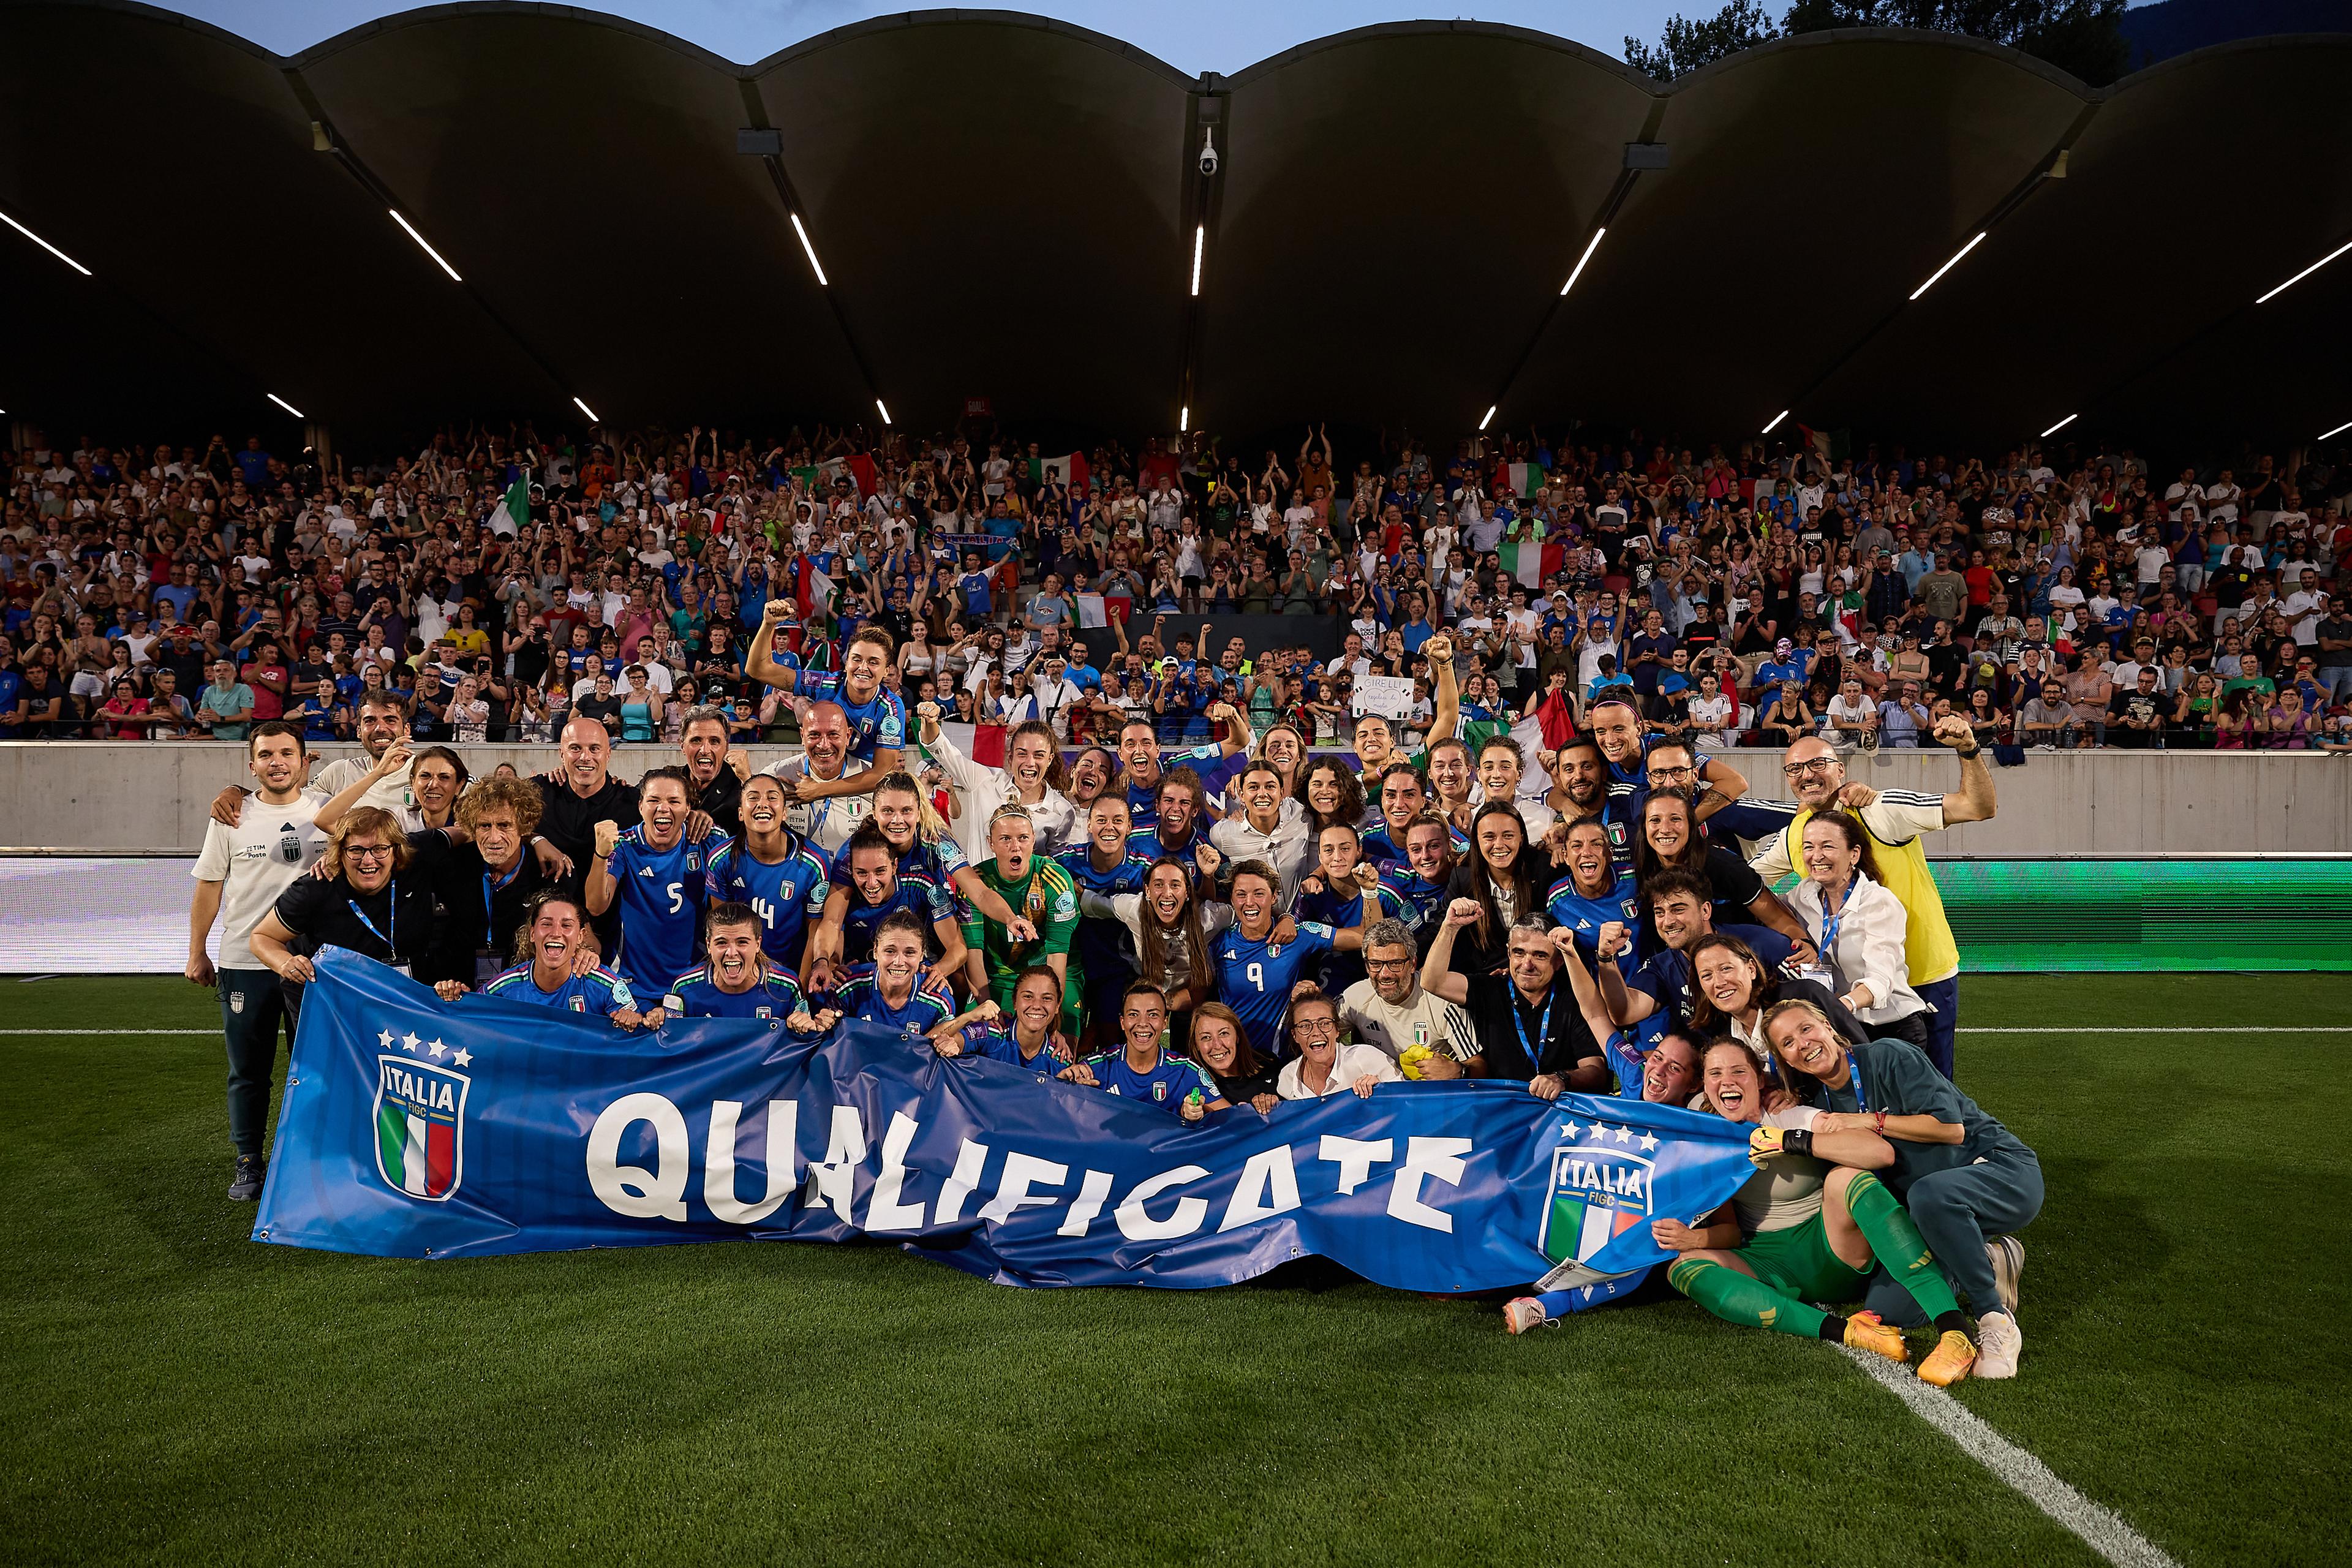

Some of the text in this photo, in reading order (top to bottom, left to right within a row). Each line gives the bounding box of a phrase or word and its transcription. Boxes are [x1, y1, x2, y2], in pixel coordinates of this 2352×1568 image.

[968, 401, 985, 412] GOAL!
[1364, 679, 1401, 688] GIRELLI
[666, 883, 684, 914] 5
[752, 897, 775, 930] 14
[1424, 897, 1438, 923] 2
[1246, 962, 1264, 992] 9
[385, 1065, 456, 1112] ITALIA
[407, 1101, 428, 1118] FIGC
[586, 1092, 1472, 1240] QUALIFICATE
[1559, 1157, 1643, 1199] ITALIA
[1588, 1191, 1616, 1207] FIGC
